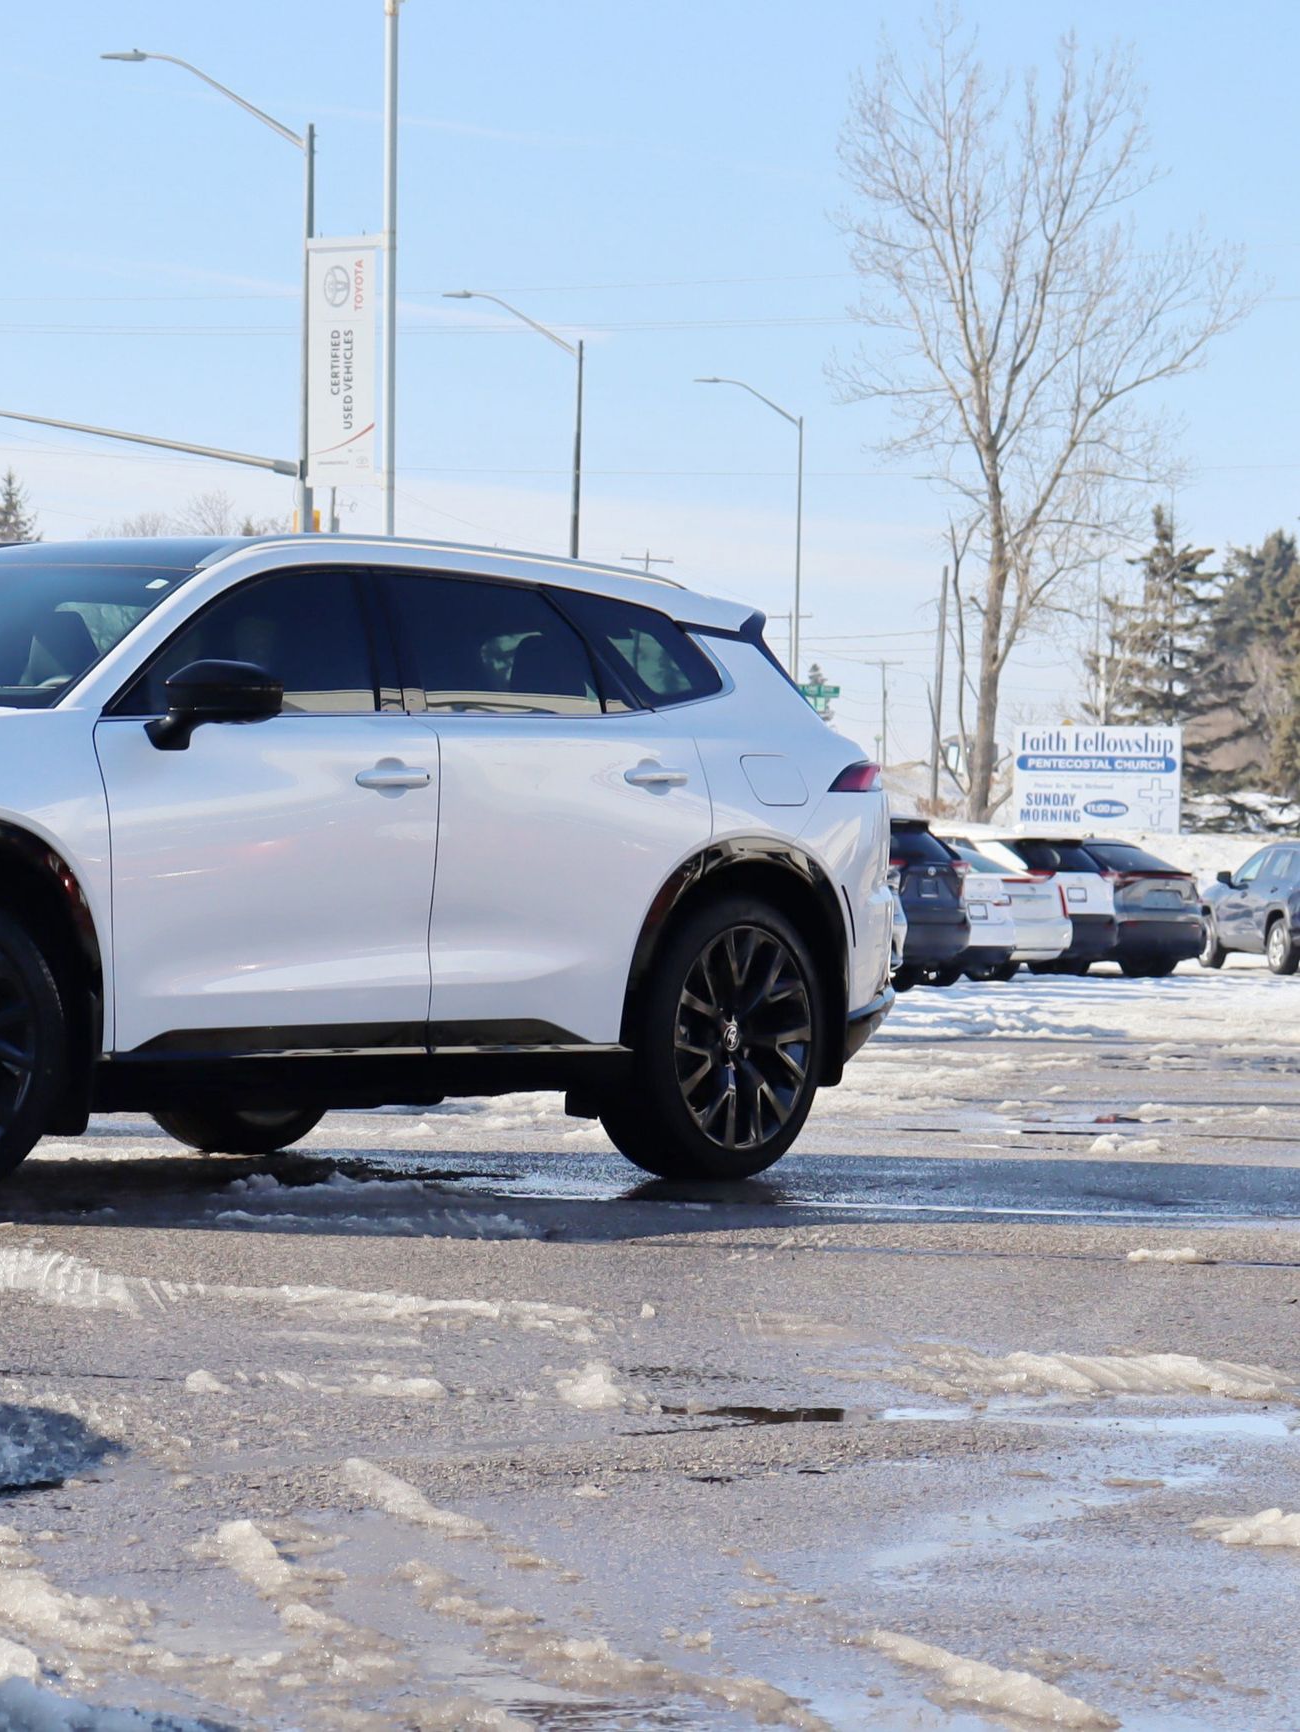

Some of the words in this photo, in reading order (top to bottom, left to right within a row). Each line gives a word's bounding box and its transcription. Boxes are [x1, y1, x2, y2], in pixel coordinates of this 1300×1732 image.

[354, 259, 364, 312] TOYOTA
[330, 329, 341, 396] CERTIFIED
[343, 329, 353, 392] VEHICLES
[343, 394, 353, 430] USED
[1021, 731, 1067, 751] Faith
[1074, 731, 1174, 758] Fellowship
[1027, 758, 1112, 770] PENTECOSTAL
[1114, 759, 1165, 771] CHURCH
[1025, 792, 1076, 807] SUNDAY
[1020, 808, 1081, 823] MORNING
